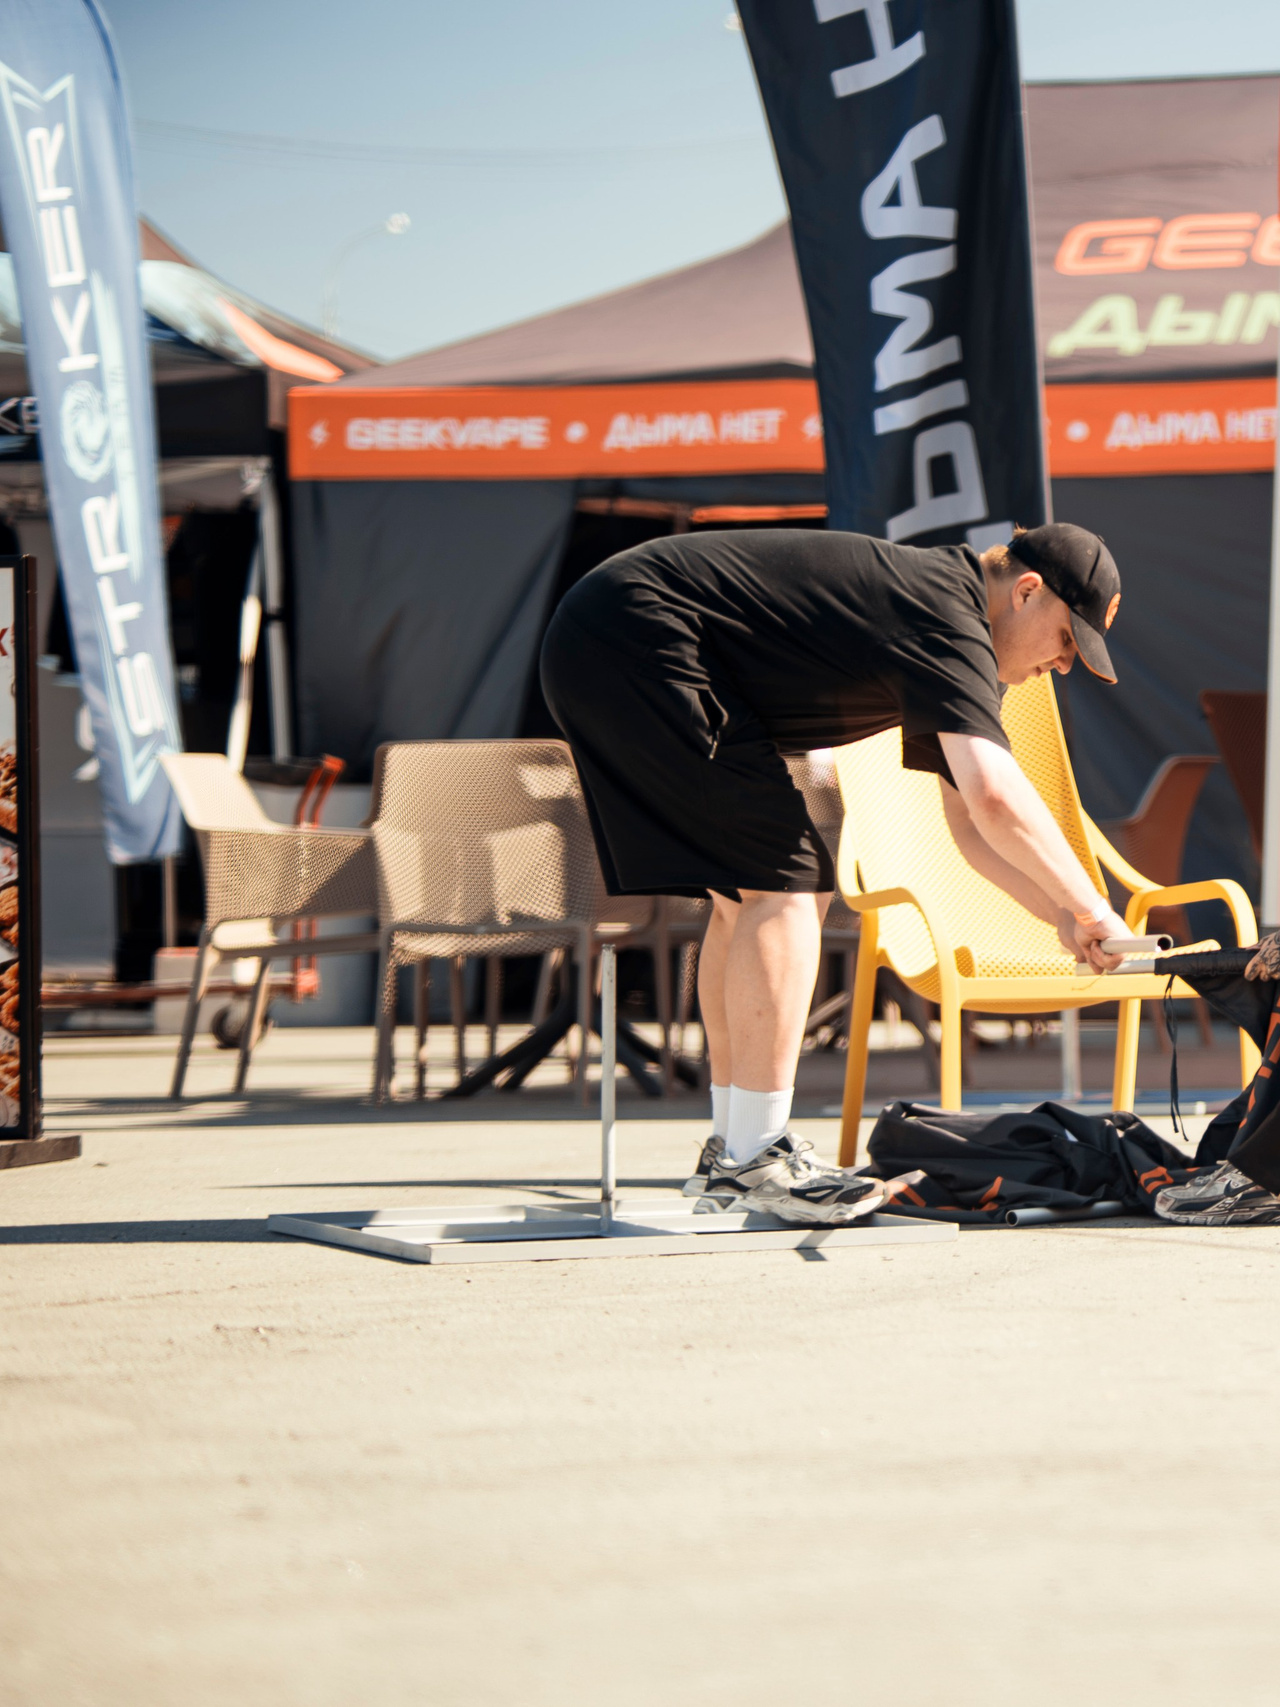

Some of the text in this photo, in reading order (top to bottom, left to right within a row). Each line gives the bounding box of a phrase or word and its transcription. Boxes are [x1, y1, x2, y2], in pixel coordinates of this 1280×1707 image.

[862, 114, 1014, 550] ЫМА
[345, 417, 551, 450] GEEKVAPE
[603, 407, 786, 453] ДЫМА НЕТ
[1104, 407, 1279, 450] ДЫМА НЕ
